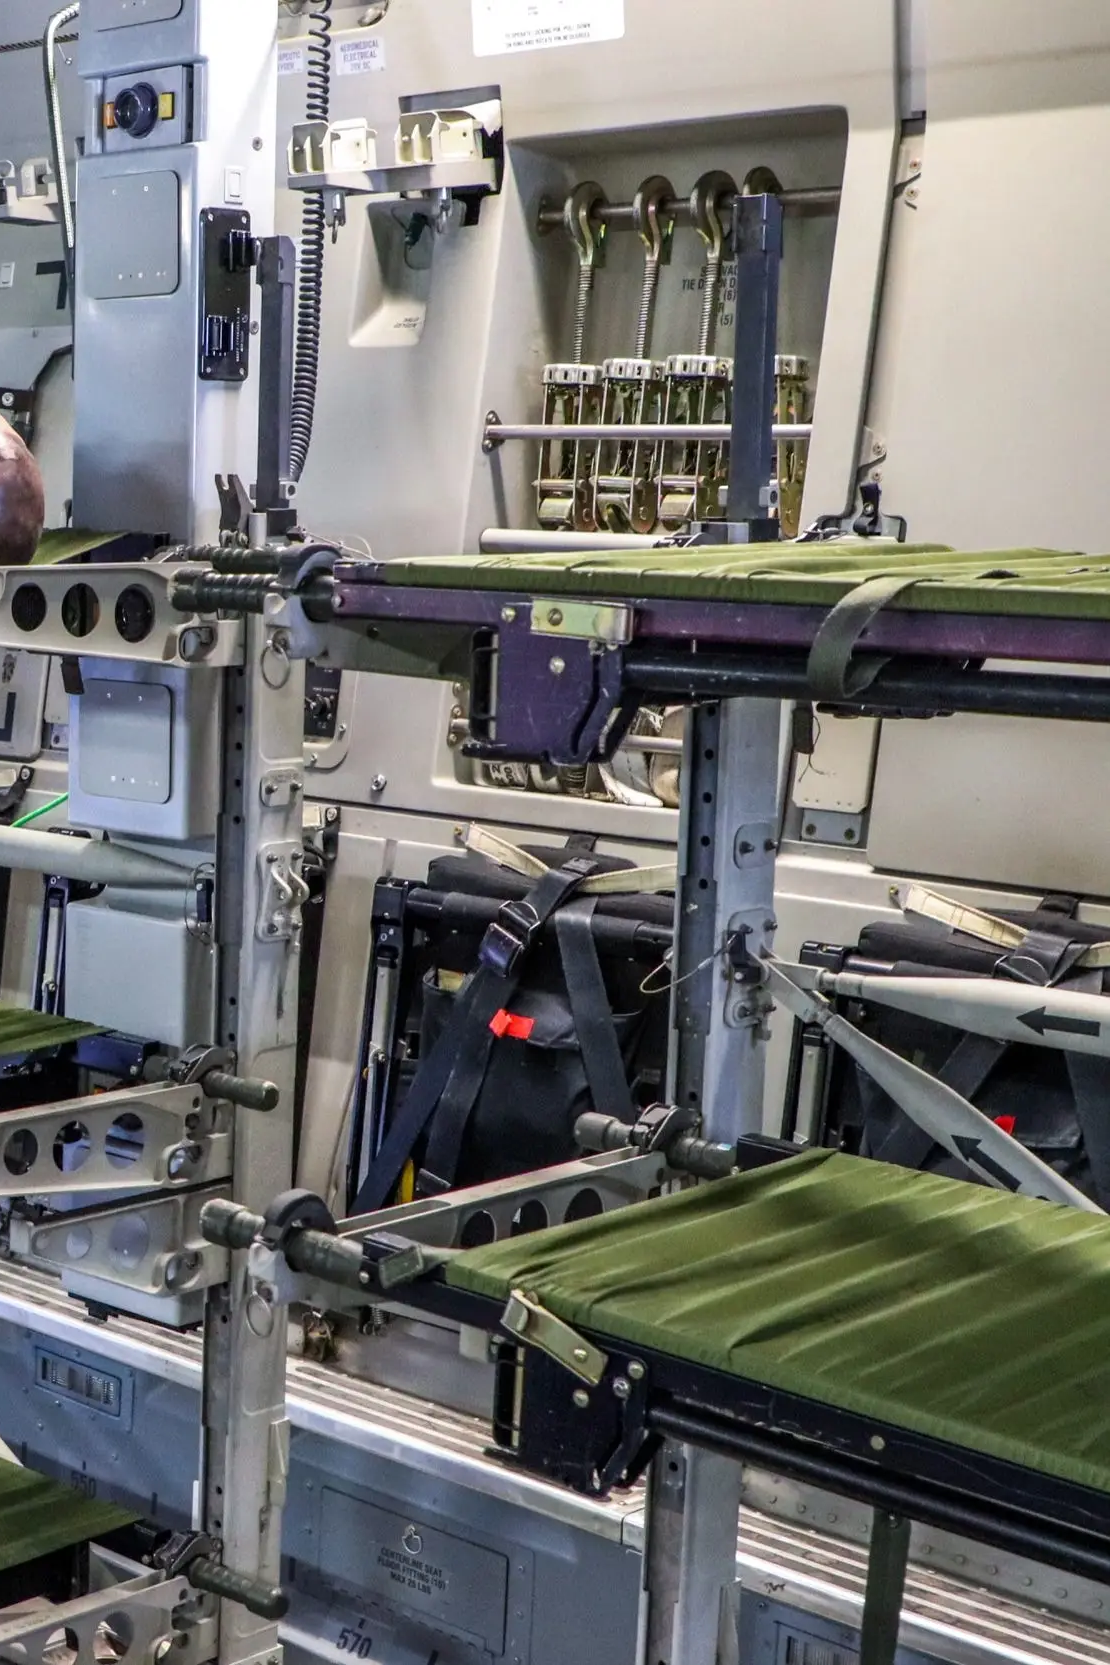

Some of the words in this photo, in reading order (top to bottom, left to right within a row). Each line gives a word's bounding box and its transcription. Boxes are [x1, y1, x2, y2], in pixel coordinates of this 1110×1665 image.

[340, 39, 378, 52] AEROMEDICAL
[343, 50, 377, 62] ELECTRICAL
[682, 279, 695, 290] TIE
[378, 1555, 401, 1571] FLOOR
[401, 1564, 430, 1584] FITTING
[381, 1547, 424, 1570] CENTERLINE
[424, 1563, 442, 1578] SEAT
[390, 1571, 406, 1584] MAX
[417, 1582, 432, 1595] LBS
[336, 1627, 372, 1659] 570
